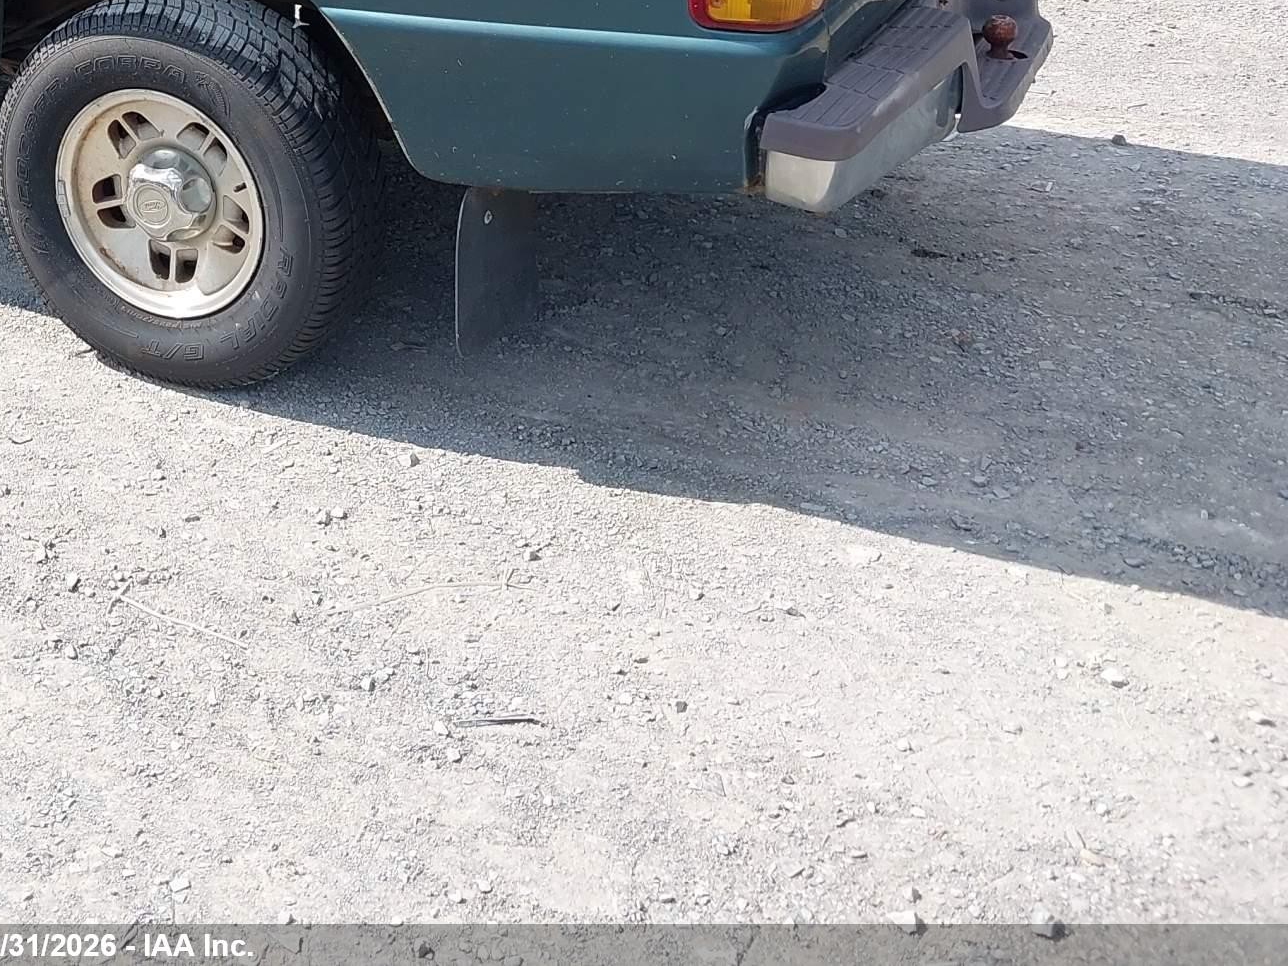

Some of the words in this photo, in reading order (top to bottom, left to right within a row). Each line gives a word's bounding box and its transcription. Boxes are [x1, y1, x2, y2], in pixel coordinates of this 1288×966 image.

[74, 54, 185, 84] COBRA
[220, 245, 294, 350] RADIAL
[142, 338, 205, 361] G/T
